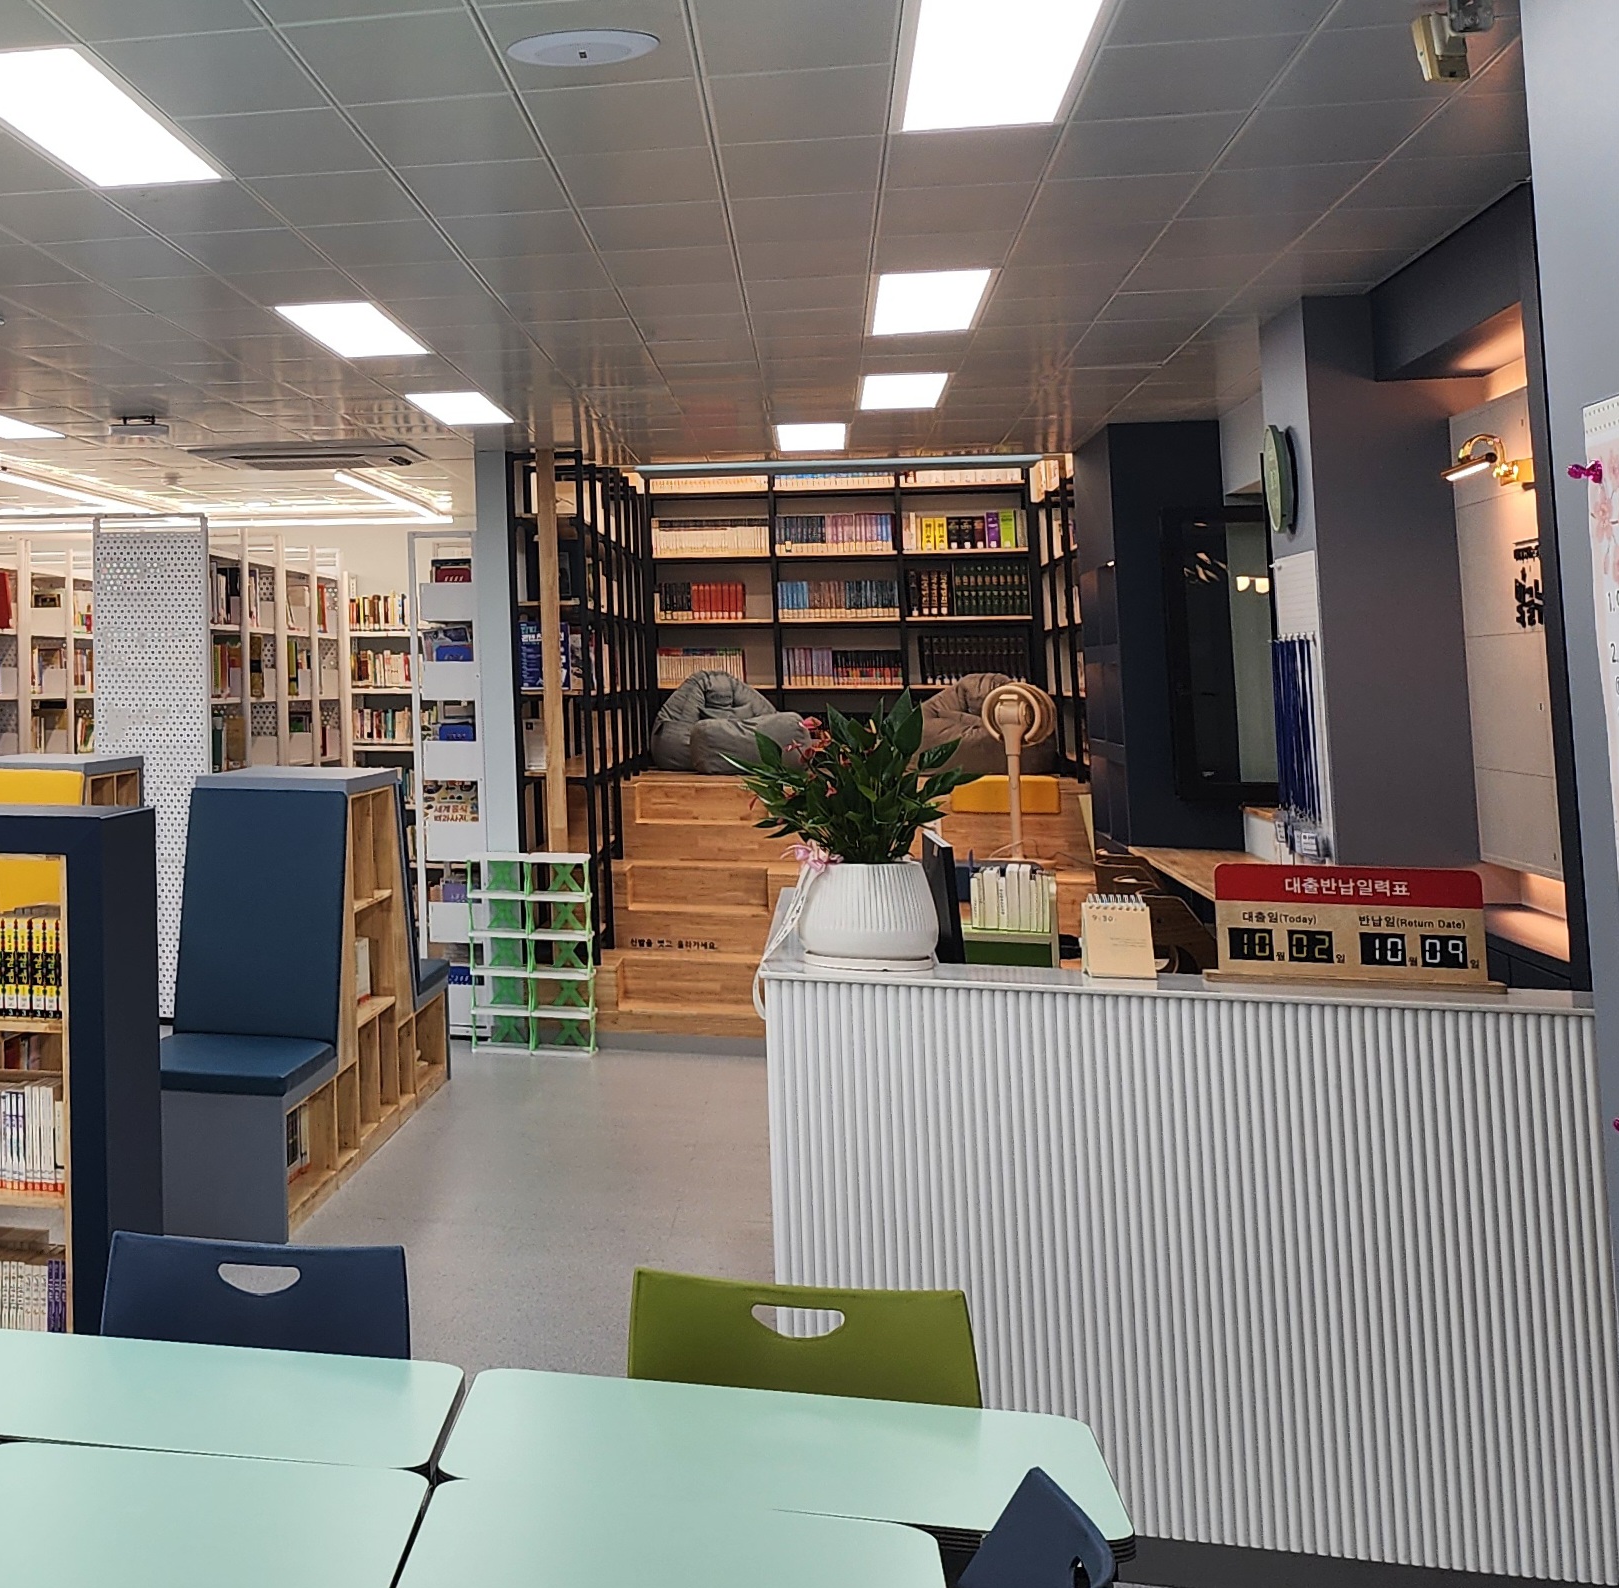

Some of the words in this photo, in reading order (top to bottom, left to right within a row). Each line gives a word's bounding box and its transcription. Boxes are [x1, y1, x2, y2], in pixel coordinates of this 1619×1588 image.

[1284, 877, 1411, 897] 대출반납일력표
[1243, 932, 1270, 957] 10
[1292, 934, 1330, 960] 02
[1375, 938, 1402, 962] 10
[1425, 939, 1463, 963] 09
